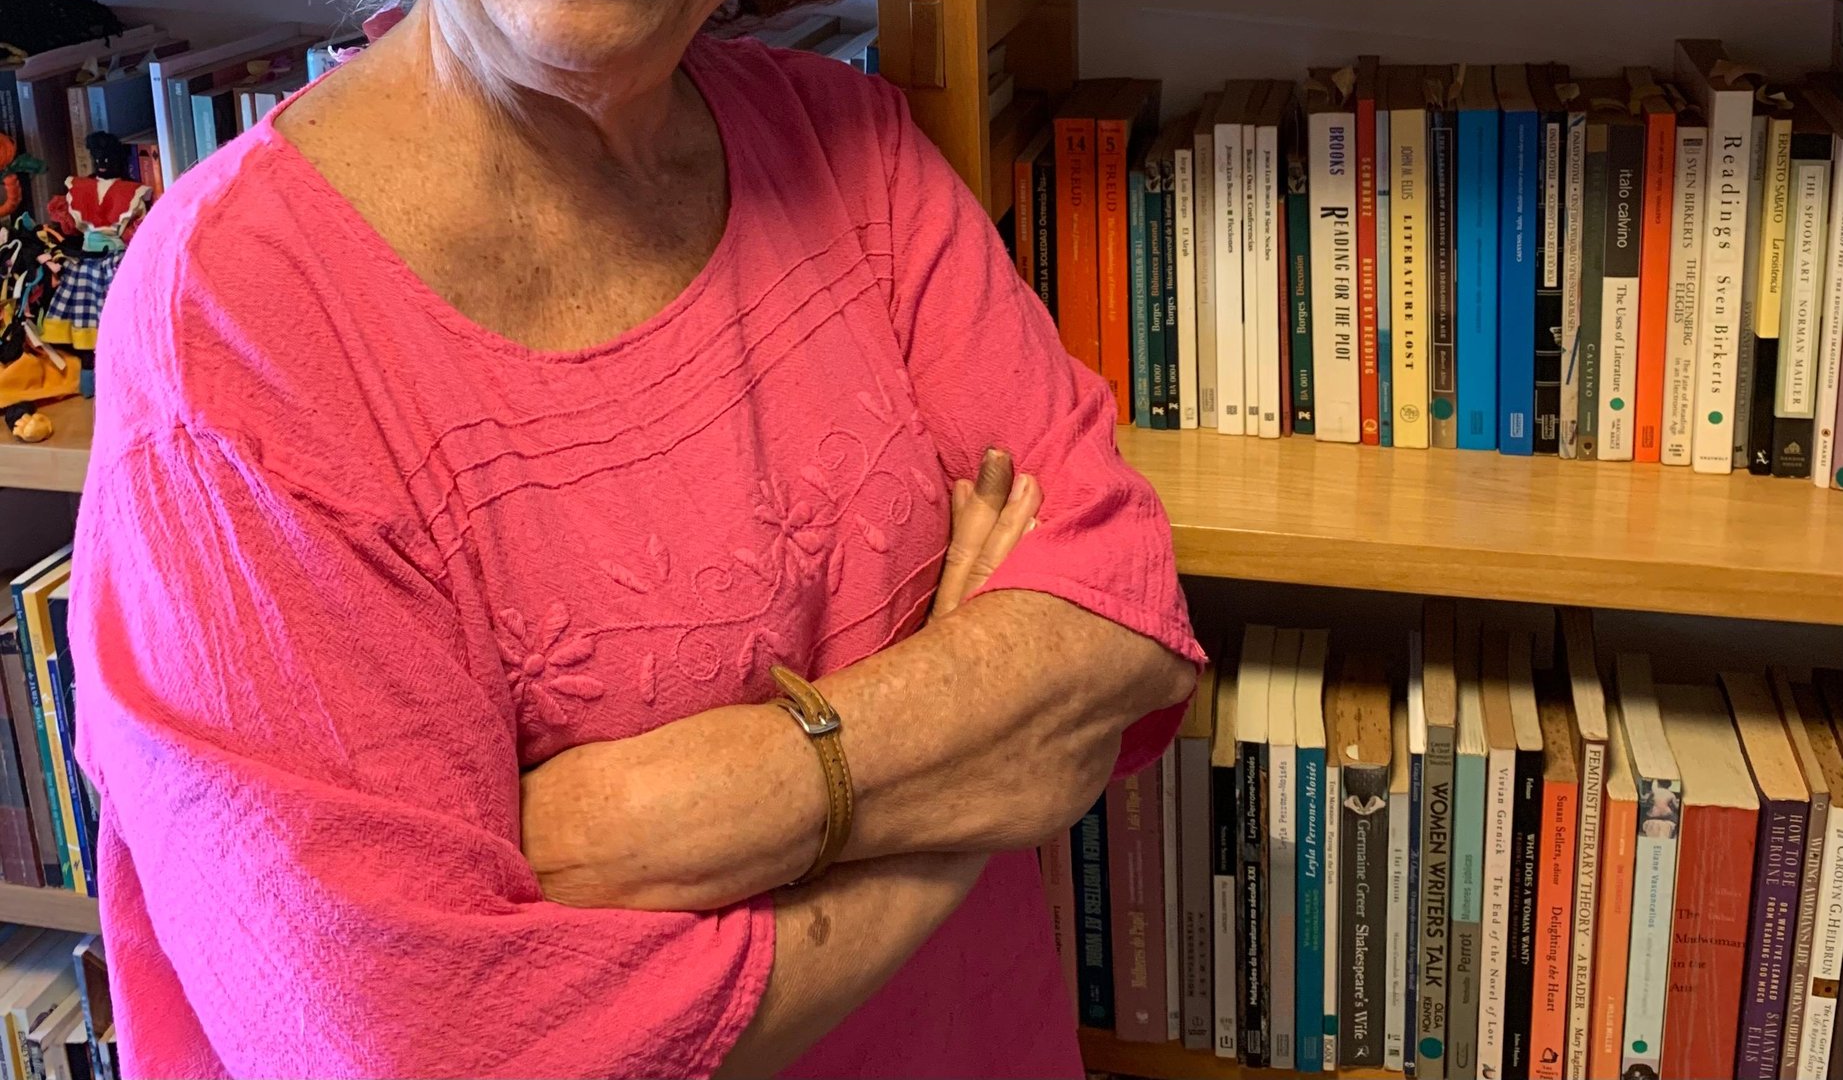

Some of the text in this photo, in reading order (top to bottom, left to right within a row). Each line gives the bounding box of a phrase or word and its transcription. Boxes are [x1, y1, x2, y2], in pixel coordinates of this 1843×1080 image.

[1329, 127, 1345, 176] BROOKS
[1616, 169, 1633, 249] italo calvino
[1320, 206, 1351, 361] READING FOR THE PLOT
[1403, 215, 1415, 370] LITERATURE LOST
[1711, 135, 1742, 395] Readings Sven Birkerts
[1792, 175, 1817, 406] THE SPOOKY ART NORMAN MAILER
[1296, 301, 1307, 334] Borges
[1612, 284, 1627, 393] The Uses of Literature
[1307, 761, 1318, 845] Perrone-Moisés
[1557, 795, 1568, 823] Susan
[1305, 846, 1320, 878] Leyla
[1553, 825, 1567, 860] Sellers,
[1765, 813, 1786, 885] A HEROINE
[1781, 814, 1803, 888] HOW TO BE
[1425, 782, 1449, 988] WOMEN WRITERS TALK
[1574, 749, 1602, 1009] FEMINIST LITERARY THEORY A READER
[1353, 819, 1371, 1040] Germaine Greer Shakespeare's Wife
[1458, 933, 1473, 973] Perrot
[1545, 905, 1563, 962] Delighting
[1546, 983, 1560, 1013] Heart
[1548, 964, 1560, 981] the
[1422, 996, 1432, 1033] KENYON
[1433, 1002, 1444, 1030] OLGA
